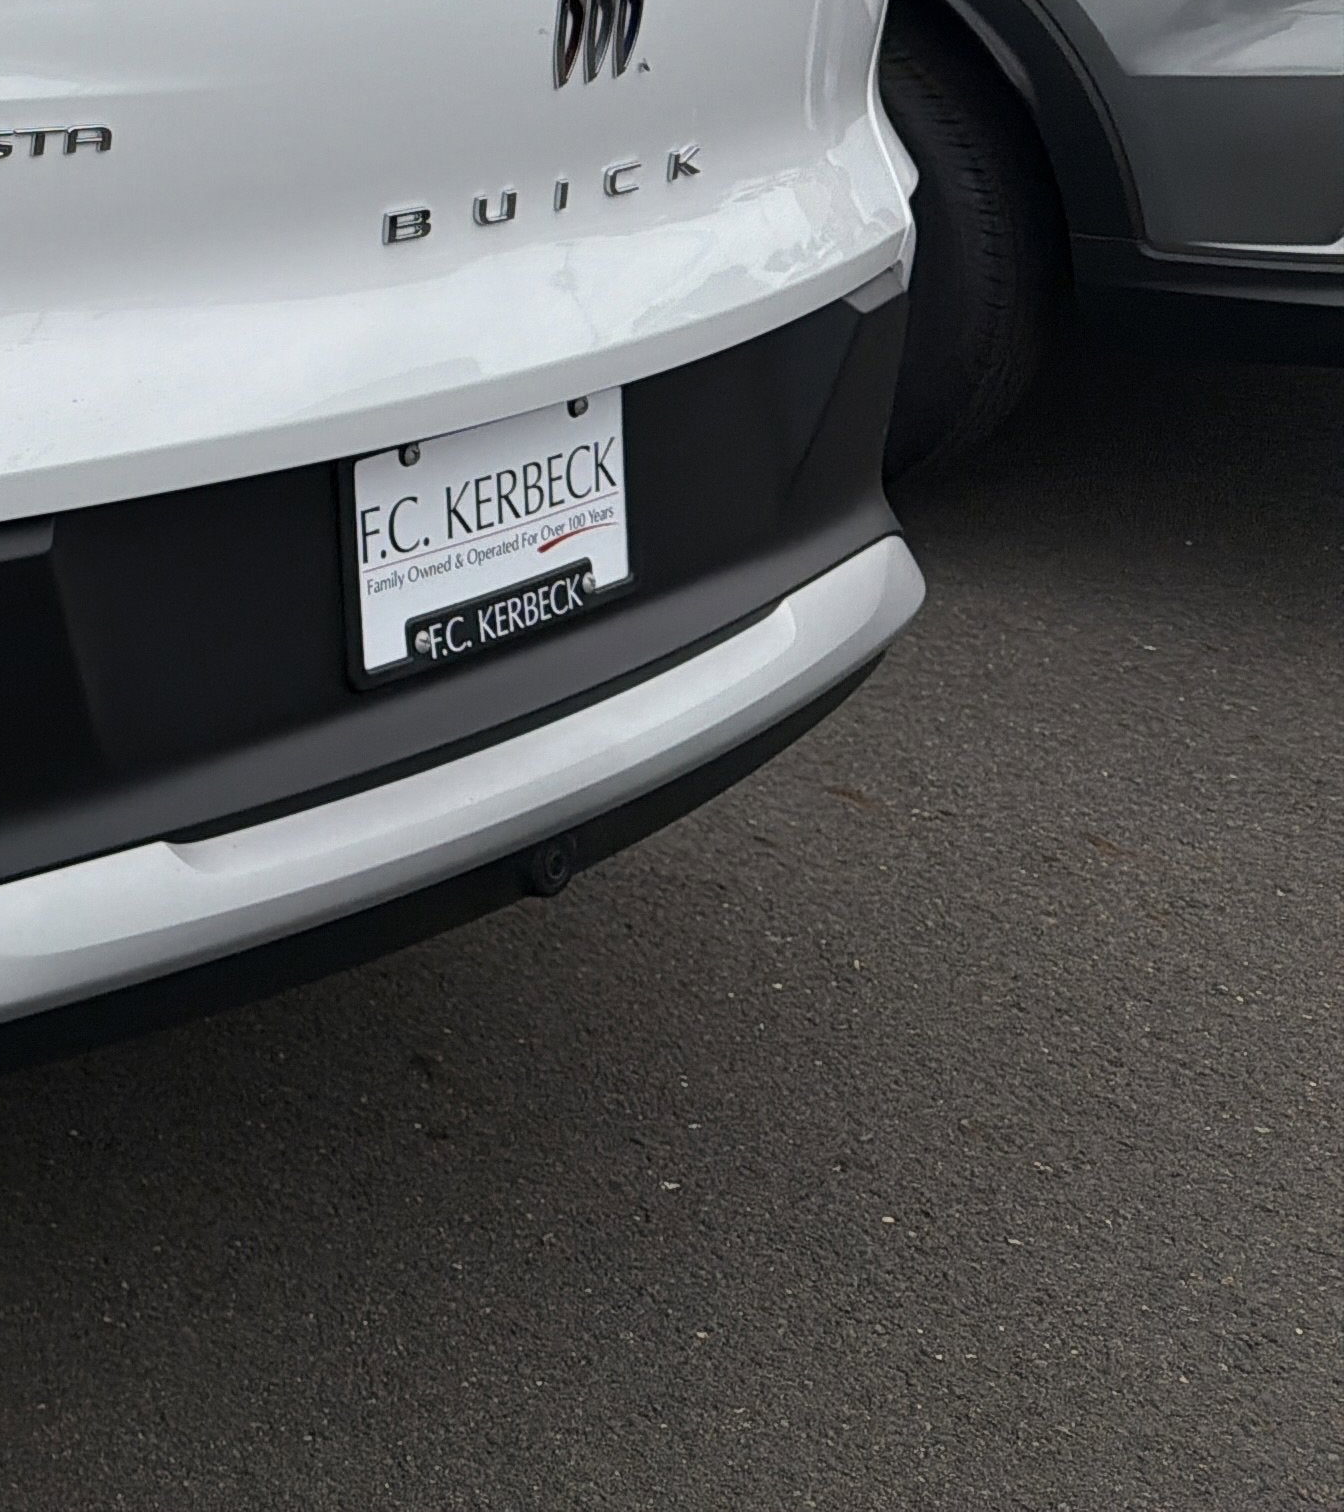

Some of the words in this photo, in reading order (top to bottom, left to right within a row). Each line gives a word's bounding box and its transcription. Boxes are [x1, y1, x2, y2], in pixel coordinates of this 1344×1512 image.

[382, 143, 701, 246] BUICK
[360, 495, 430, 564] F.C.
[445, 436, 617, 539] KERBECK
[366, 570, 405, 595] Family
[407, 557, 451, 583] Owned
[455, 554, 464, 570] &
[467, 538, 520, 566] Operated
[521, 531, 538, 548] For
[540, 522, 565, 542] Over
[568, 512, 586, 531] 100
[587, 506, 615, 524] Years
[428, 616, 473, 660] F.C.
[477, 573, 584, 643] KERBECK
